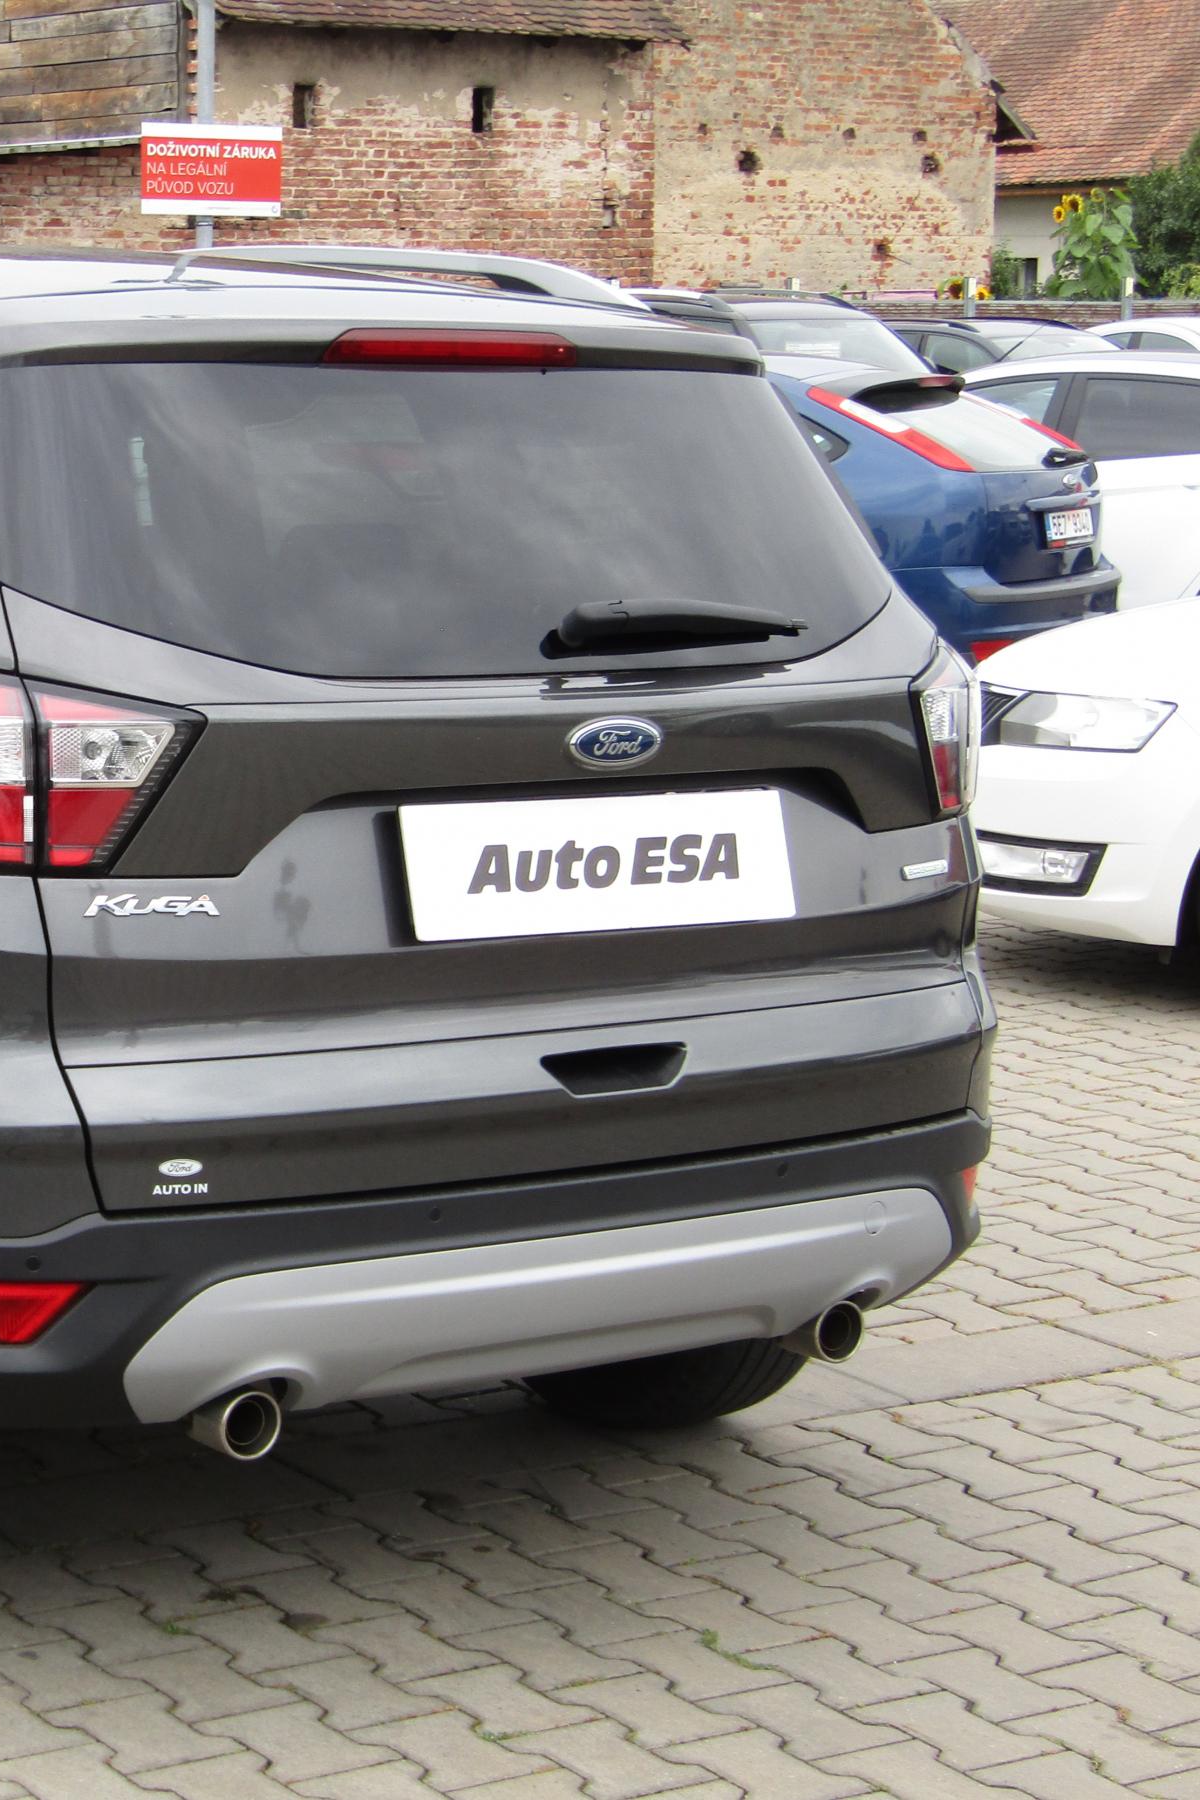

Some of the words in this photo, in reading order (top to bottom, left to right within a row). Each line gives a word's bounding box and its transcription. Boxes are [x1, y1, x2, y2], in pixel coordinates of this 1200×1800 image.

[146, 142, 220, 158] DOŽIVOTNÍ
[223, 144, 277, 160] ZÁRUKA
[146, 162, 166, 175] NA
[170, 161, 228, 177] LEGÁLNÍ
[146, 177, 194, 194] PŮVOD
[197, 181, 234, 195] VOZU
[593, 729, 644, 756] Ford
[467, 840, 621, 895] Auto
[630, 832, 740, 886] ESA
[83, 893, 221, 917] KUGA
[167, 1161, 194, 1173] Ford
[152, 1184, 192, 1195] AUTO
[193, 1183, 208, 1194] IN
